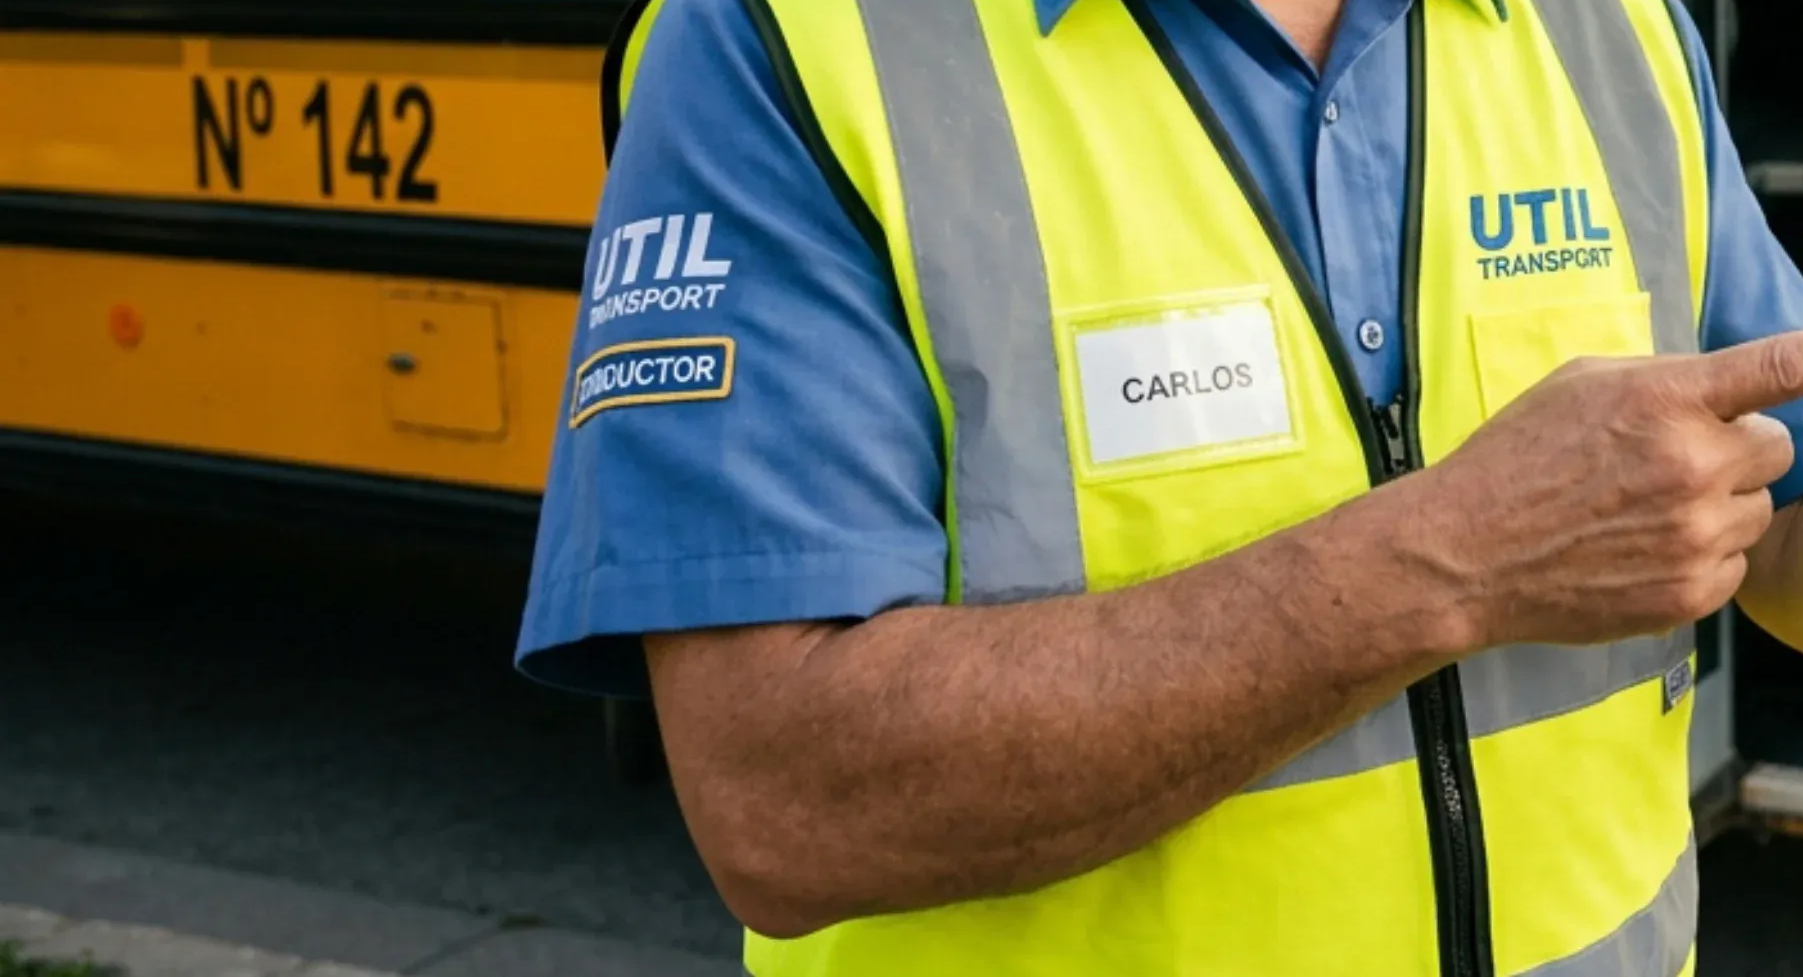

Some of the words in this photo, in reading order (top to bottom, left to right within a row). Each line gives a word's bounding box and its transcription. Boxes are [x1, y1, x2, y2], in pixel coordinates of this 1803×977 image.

[193, 74, 274, 192] Nº
[302, 78, 438, 203] 142
[591, 212, 732, 301] UTIL
[1470, 188, 1610, 251] UTIL
[1121, 362, 1254, 404] CARLOS
